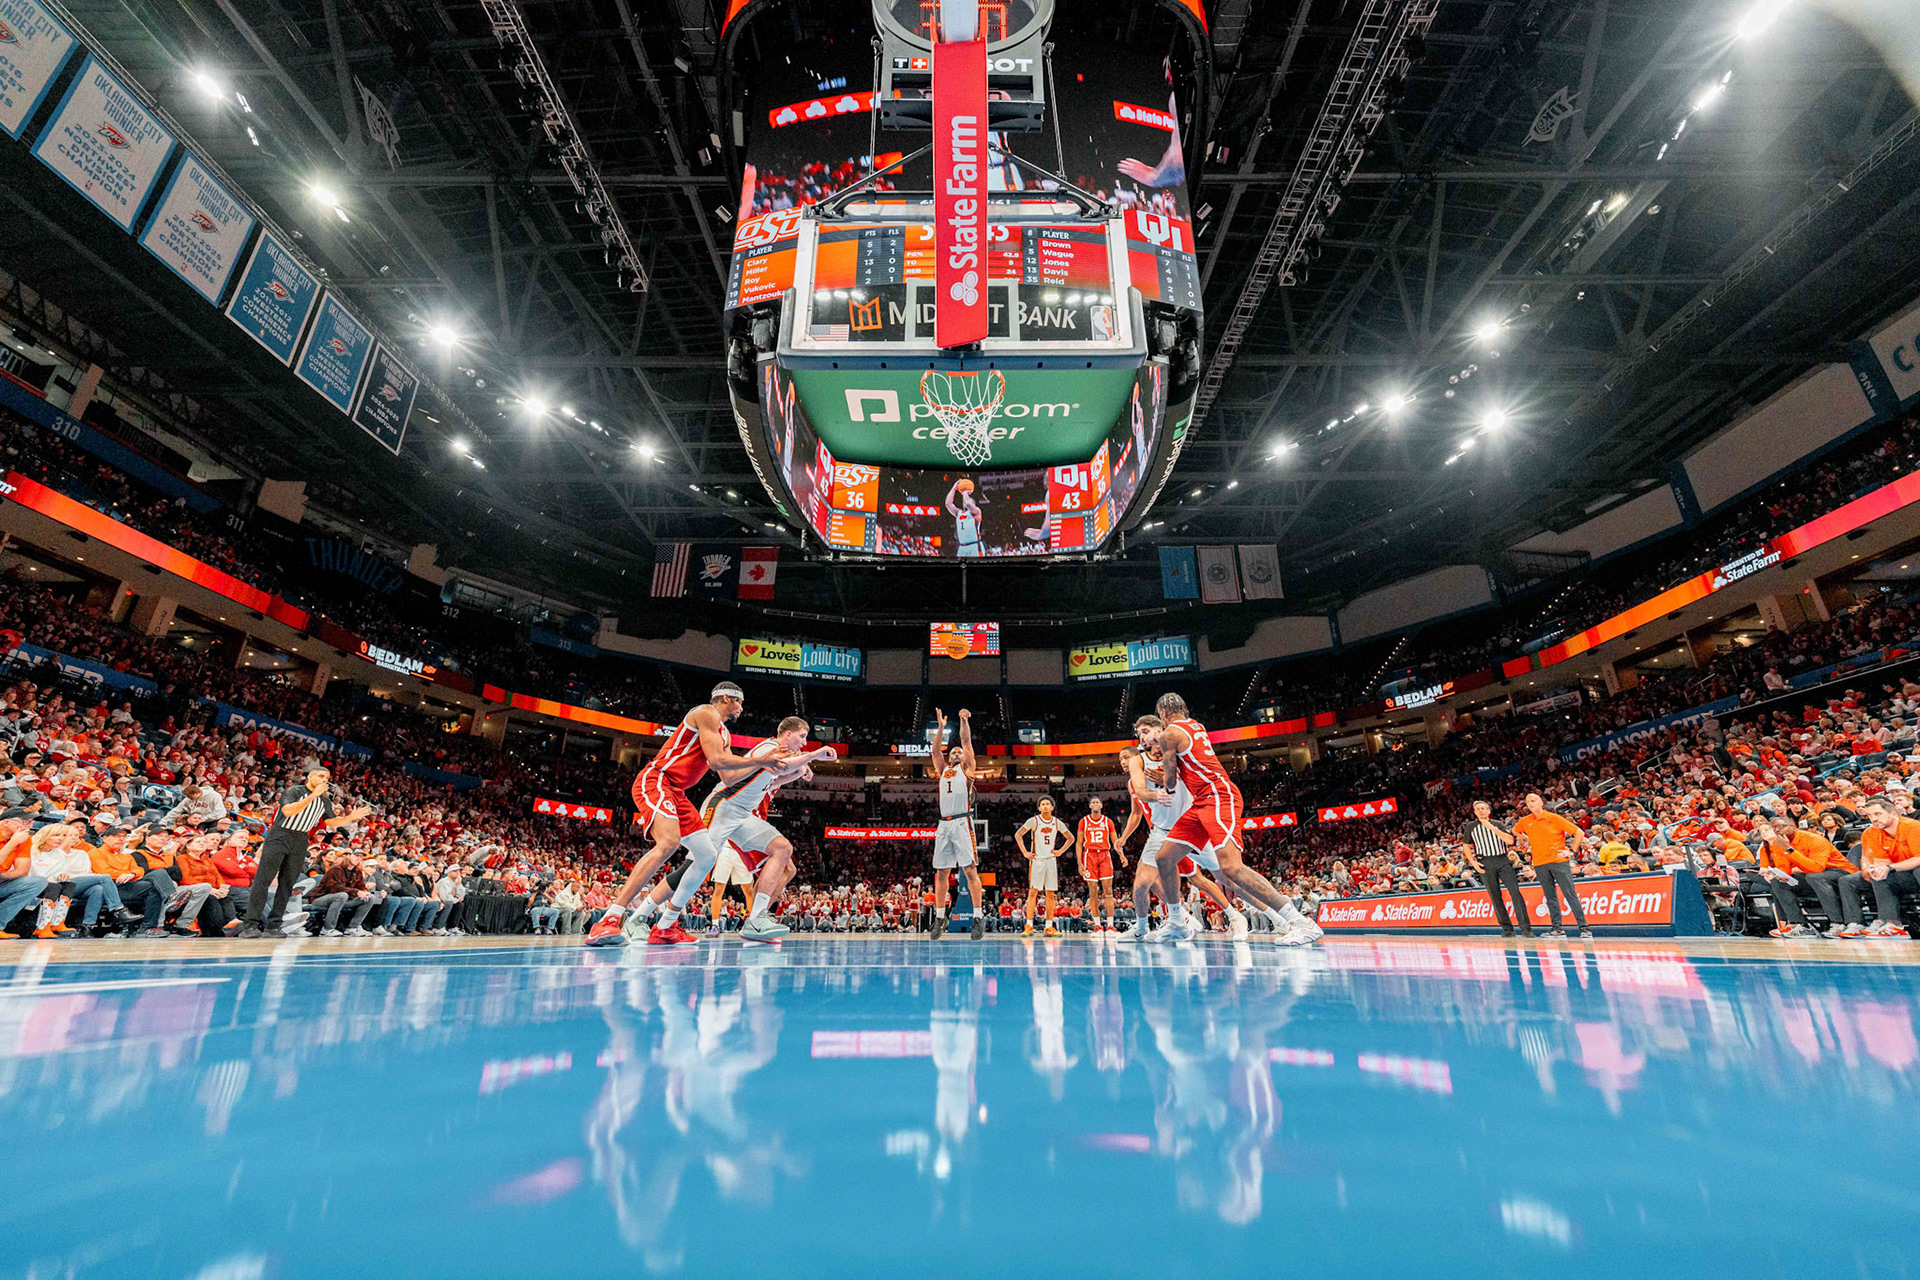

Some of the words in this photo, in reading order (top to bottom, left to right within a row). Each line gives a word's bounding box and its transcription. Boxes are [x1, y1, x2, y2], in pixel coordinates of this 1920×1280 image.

[34, 15, 61, 42] CITY
[94, 73, 144, 124] OKLAHOMA
[146, 120, 164, 145] CITY
[103, 99, 145, 145] THUNDER
[64, 127, 137, 192] NORTHWEST
[74, 124, 136, 181] 2023-2024
[57, 143, 128, 207] CHAMPIONS
[70, 140, 124, 191] DIVISION
[189, 167, 228, 209] OKLAHOMA
[228, 205, 245, 225] CITY
[946, 115, 978, 270] StateFarm
[196, 189, 230, 228] THUNDER
[164, 218, 224, 271] NORTHWEST
[172, 214, 222, 260] 2024-2025
[1042, 230, 1070, 240] PLAYER
[1042, 240, 1072, 249] Brown
[159, 233, 216, 284] CHAMPIONS
[169, 233, 212, 272] DIVISION
[747, 258, 768, 267] Clary
[748, 245, 773, 257] PLAYER
[1042, 249, 1075, 259] Wague
[1042, 259, 1070, 267] Jones
[266, 242, 299, 281] OKLAHOMA
[297, 272, 312, 291] CITY
[271, 261, 300, 294] THUNDER
[746, 266, 768, 276] Miller
[1043, 268, 1069, 276] Davis
[744, 277, 761, 285] Roy
[744, 282, 776, 294] Vukovic
[1043, 277, 1065, 285] Reid
[254, 288, 293, 323] 2011-2012
[742, 290, 785, 304] Mantzouka
[242, 295, 292, 341] CONFERENCE
[242, 304, 287, 345] CHAMPIONS
[252, 295, 290, 330] WESTERN
[354, 328, 366, 344] CITY
[309, 355, 351, 391] CONFERENCE
[317, 352, 348, 381] WESTERN
[318, 346, 350, 375] 2024-2025
[309, 363, 347, 396] CHAMPIONS
[1859, 372, 1878, 400] 322
[365, 406, 398, 435] CHAMPIONS
[370, 395, 399, 421] 2024-2025
[377, 408, 389, 421] NBA
[52, 416, 81, 441] 310
[820, 475, 829, 497] 43
[845, 491, 864, 509] 36
[1061, 492, 1081, 510] 43
[226, 514, 244, 532] 311
[305, 537, 404, 595] THUNDER
[1720, 552, 1756, 574] PRESENTED
[1754, 547, 1765, 558] BY
[1726, 551, 1779, 583] StateFarm
[154, 610, 168, 633] 210
[442, 605, 460, 619] 312
[367, 644, 424, 673] BEDLAM
[376, 660, 411, 676] BASKETBALL
[803, 650, 832, 668] LOUD
[834, 652, 859, 673] CITY
[1131, 644, 1159, 667] LOUD
[1163, 644, 1188, 661] CITY
[782, 670, 813, 678] THUNDER
[1112, 670, 1143, 678] THUNDER
[1394, 683, 1444, 707] BEDLAM
[947, 781, 953, 794] 1
[1044, 835, 1050, 845] 5
[1089, 831, 1104, 843] 12
[1329, 906, 1367, 922] StateFarm
[1383, 902, 1433, 920] StateFarm
[1560, 889, 1661, 916] SateFarm
